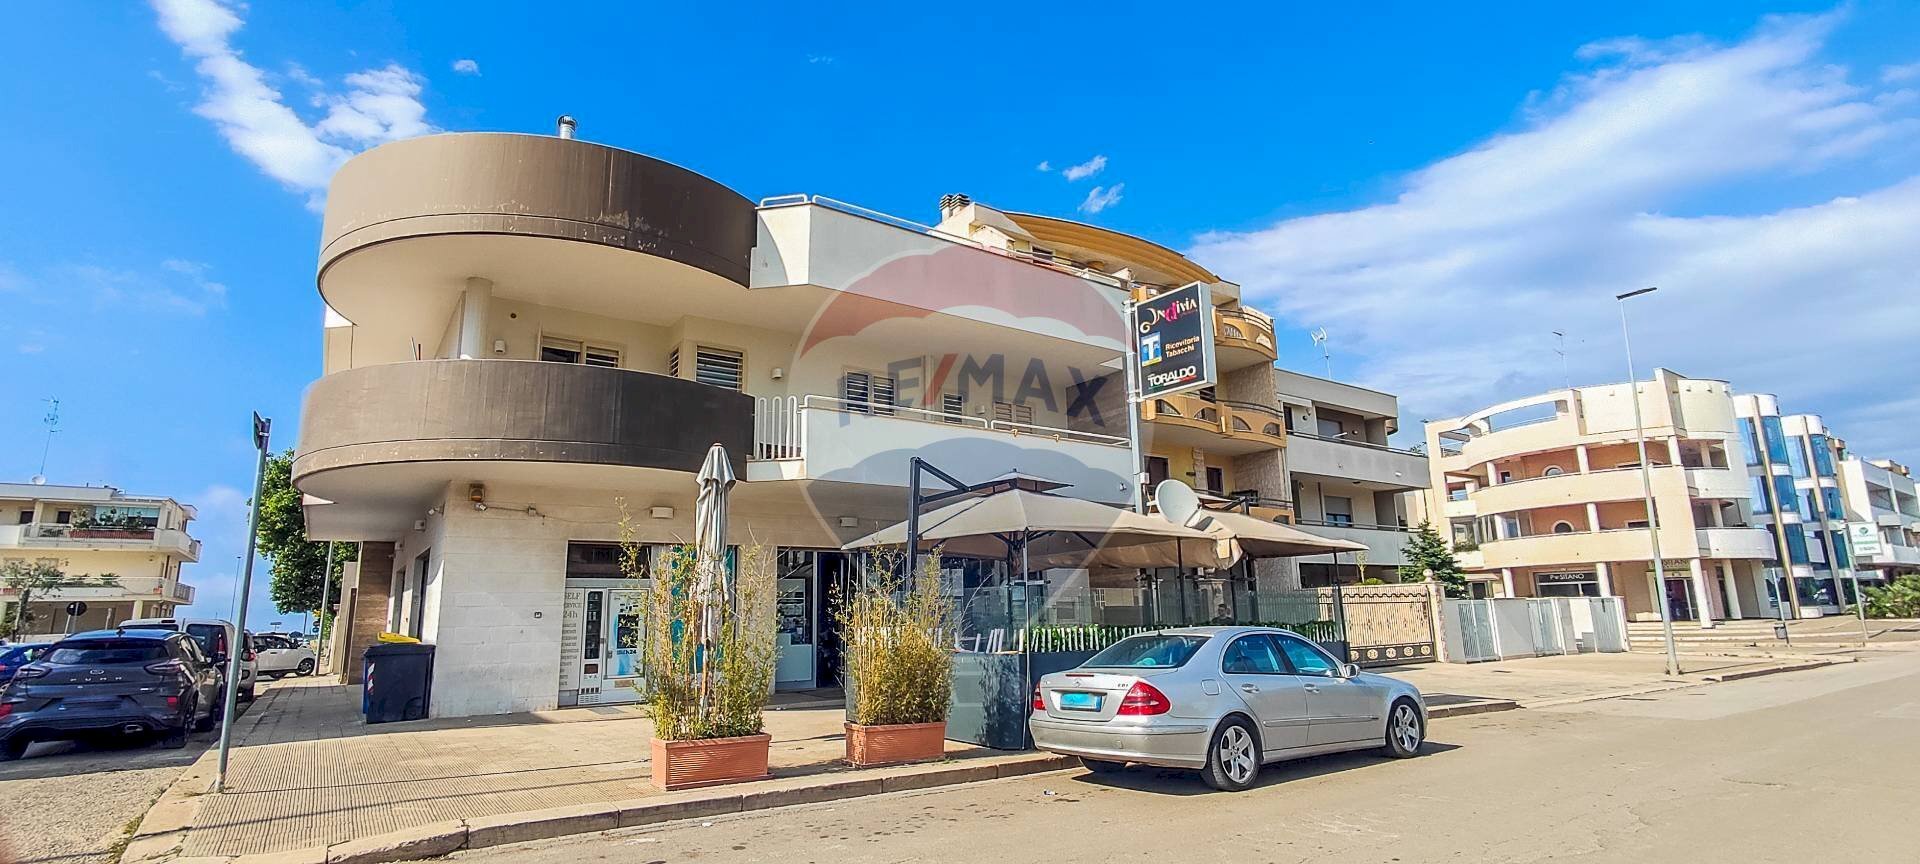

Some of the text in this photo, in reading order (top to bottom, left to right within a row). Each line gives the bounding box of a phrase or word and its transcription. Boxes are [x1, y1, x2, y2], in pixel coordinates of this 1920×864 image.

[1165, 336, 1199, 350] Ricevitoria
[1166, 344, 1195, 358] Tabacchi
[1148, 365, 1197, 387] TORALDO
